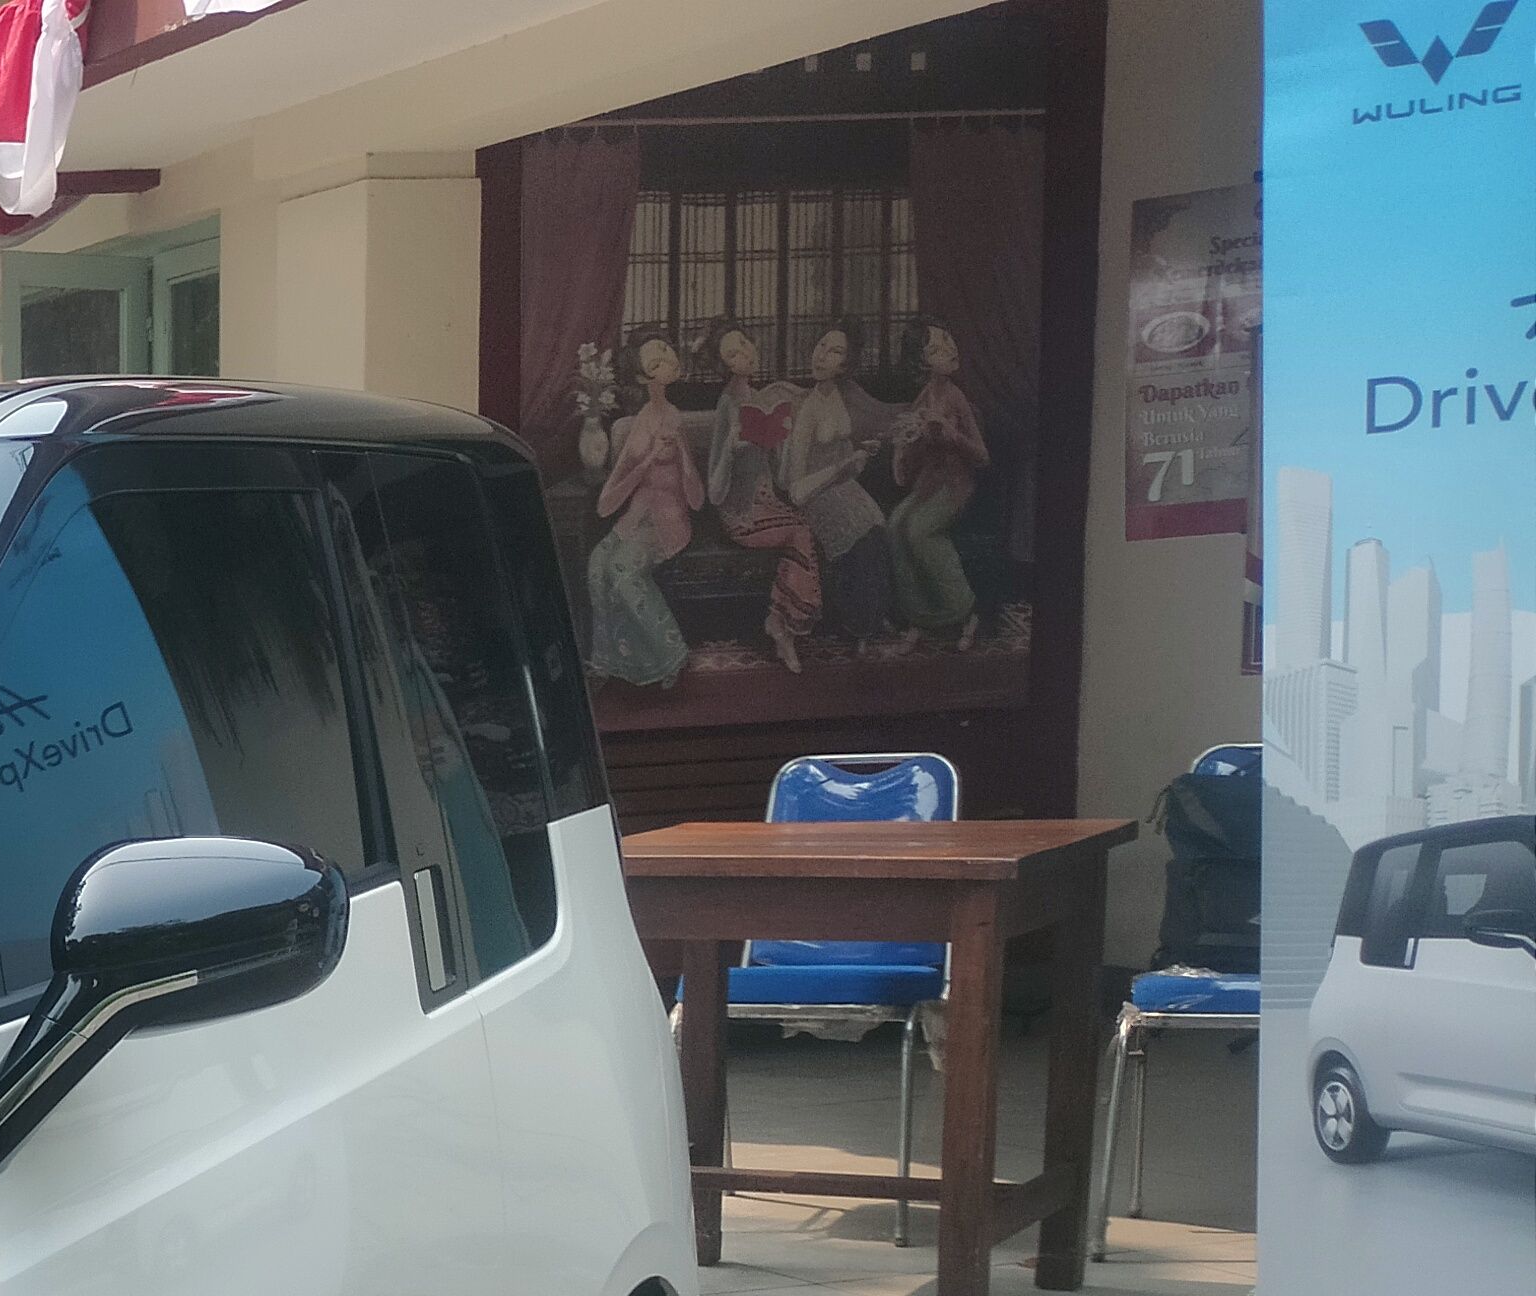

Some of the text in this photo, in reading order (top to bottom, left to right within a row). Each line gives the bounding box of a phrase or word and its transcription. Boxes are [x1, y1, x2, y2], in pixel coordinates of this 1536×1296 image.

[1352, 84, 1522, 125] WULING
[1139, 379, 1240, 405] Dapatkan
[1366, 368, 1536, 434] Driv
[1142, 449, 1194, 501] 71
